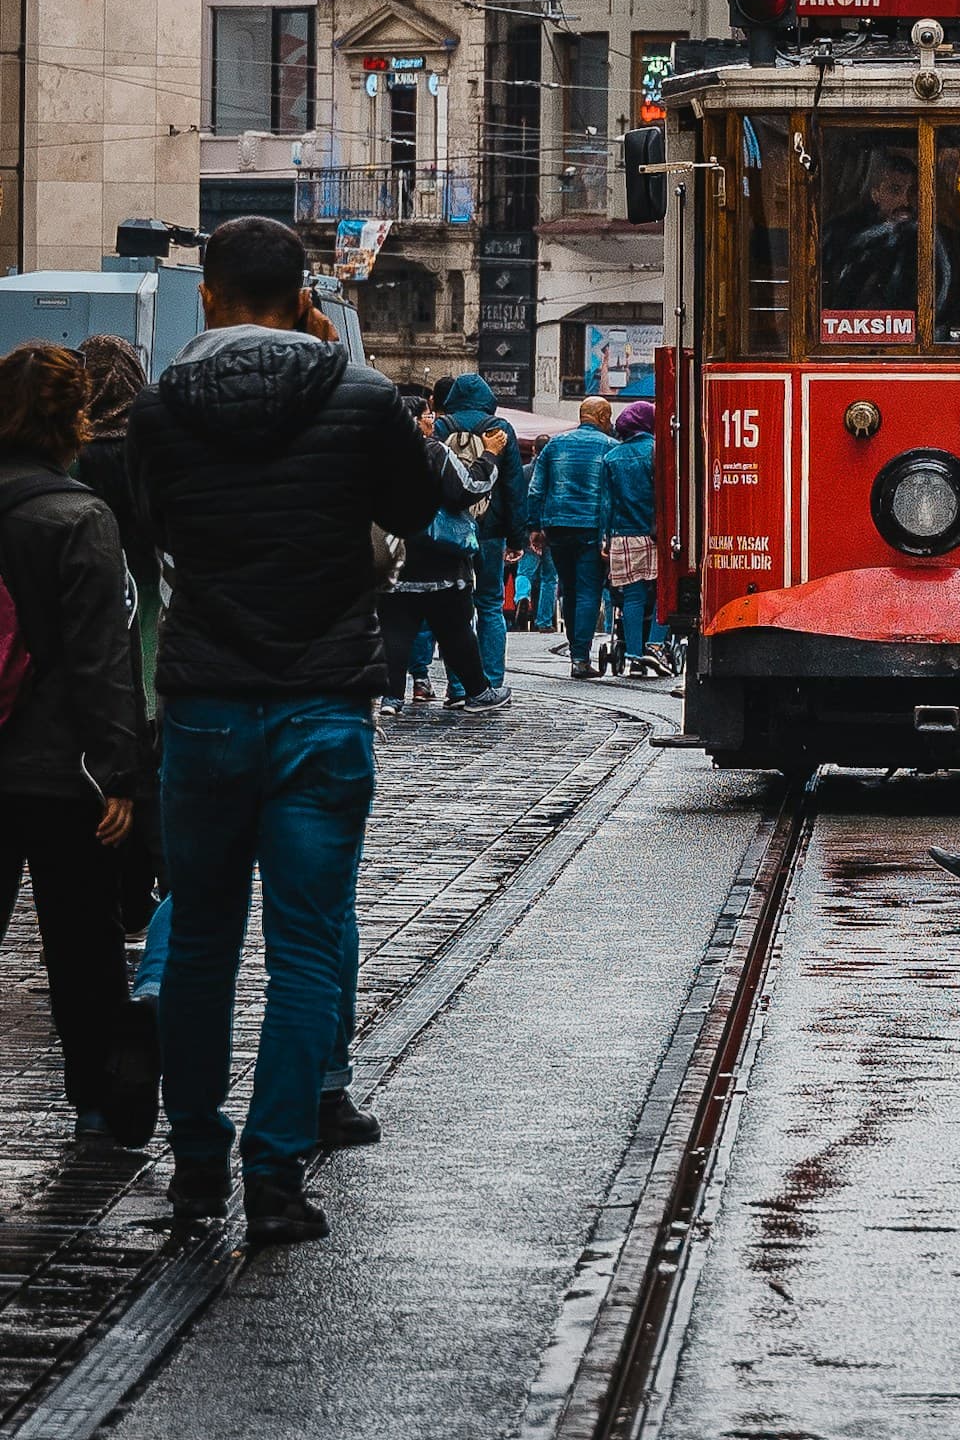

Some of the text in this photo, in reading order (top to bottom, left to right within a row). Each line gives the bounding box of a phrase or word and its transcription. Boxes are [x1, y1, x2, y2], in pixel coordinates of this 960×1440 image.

[823, 315, 912, 334] TAKSİM
[722, 409, 759, 448] 115
[723, 474, 758, 485] ALO 153
[737, 536, 769, 551] YASAK
